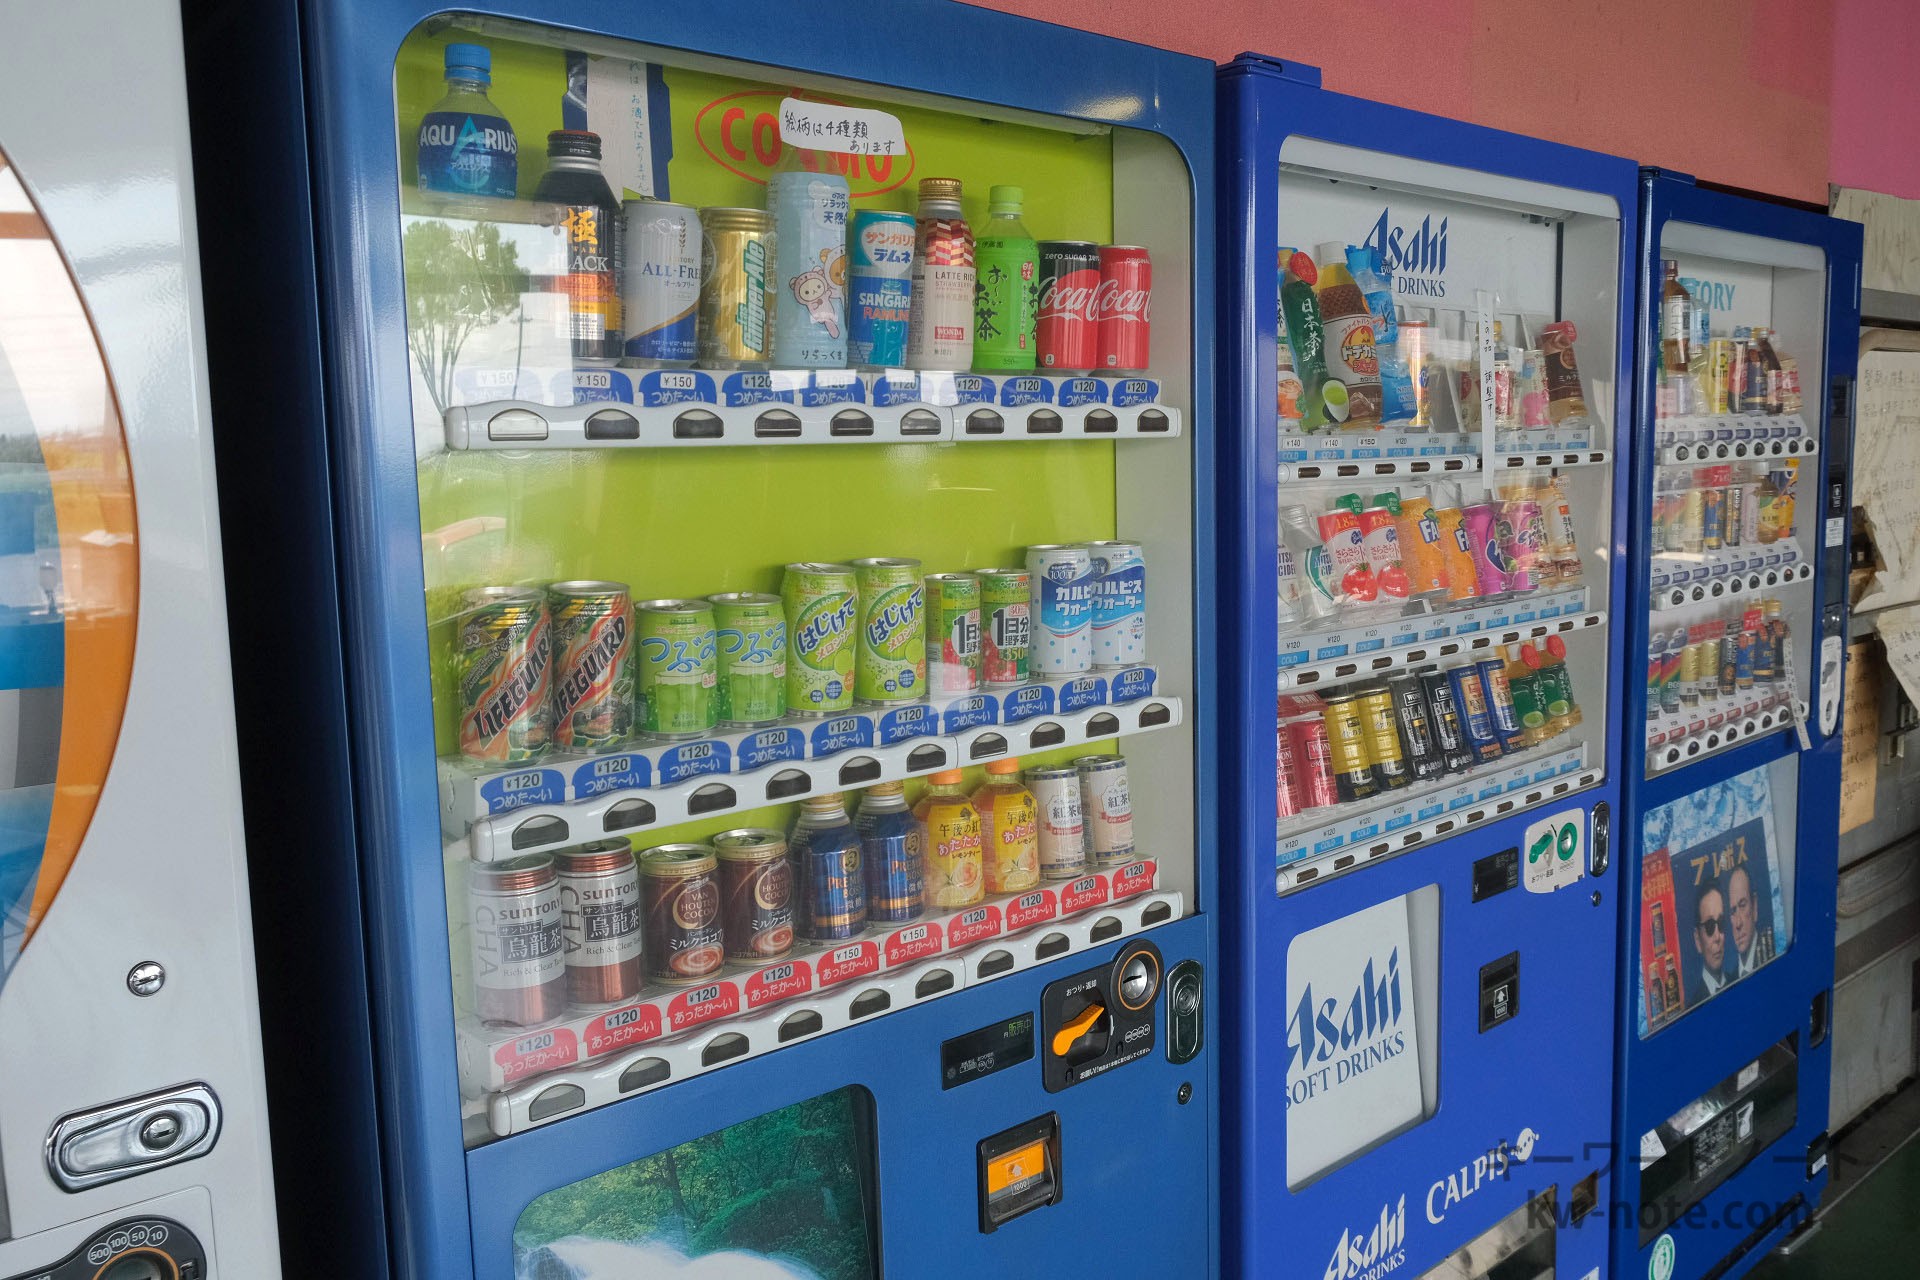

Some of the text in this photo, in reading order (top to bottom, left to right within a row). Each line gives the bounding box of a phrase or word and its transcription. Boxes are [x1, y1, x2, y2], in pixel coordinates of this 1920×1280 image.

[784, 109, 869, 139] 絵柄は4種類
[420, 115, 517, 158] AQUARIUS
[849, 139, 895, 155] あります
[560, 207, 599, 245] 極
[1362, 206, 1449, 276] Asahi
[873, 248, 911, 264] ラムネ
[935, 271, 961, 281] LATTE
[1398, 275, 1446, 299] DRINKS
[1301, 297, 1323, 356] 日本茶
[576, 374, 607, 387] ¥150
[664, 376, 692, 388] ¥150
[744, 374, 772, 388] ¥120
[958, 378, 980, 390] ¥120
[1017, 378, 1039, 391] ¥120
[1074, 381, 1094, 392] ¥120
[1127, 381, 1146, 393] ¥120
[1091, 579, 1142, 596] カルピス
[1091, 595, 1142, 611] ウォーター
[867, 585, 923, 646] はじけて
[796, 594, 855, 655] はじけて
[1281, 655, 1298, 666] COLD
[1320, 649, 1336, 658] COLD
[1125, 670, 1144, 683] ¥120
[1073, 679, 1094, 692] ¥120
[1019, 688, 1040, 701] ¥120
[899, 708, 922, 721] ¥120
[830, 719, 855, 733] ¥120
[759, 731, 785, 746] ¥120
[681, 744, 709, 759] ¥120
[597, 758, 628, 773] ¥120
[506, 773, 540, 789] ¥120
[939, 818, 981, 838] 午後の紅
[1356, 828, 1371, 838] COLD
[1319, 839, 1336, 849] COLD
[1282, 851, 1299, 861] COLD
[1125, 865, 1144, 877] ¥120
[1075, 879, 1095, 891] ¥120
[691, 891, 709, 901] VAN
[1020, 893, 1041, 907] ¥120
[584, 903, 622, 914] サントリー
[590, 908, 639, 939] 烏龍茶
[962, 910, 986, 924] ¥120
[500, 923, 542, 935] サントリー
[902, 928, 925, 942] ¥150
[507, 929, 562, 960] 烏龍茶
[585, 945, 606, 955] Rich
[837, 947, 860, 961] ¥150
[502, 966, 524, 978] Rich
[764, 965, 792, 982] ¥120
[688, 987, 718, 1003] ¥120
[1066, 980, 1097, 997] おつり・返却
[1287, 945, 1402, 1074] Asahi
[606, 1009, 639, 1027] ¥120
[1008, 1017, 1032, 1038] 販売中
[518, 1034, 552, 1053] ¥120
[1287, 1030, 1406, 1111] SOFT DRINKS
[1426, 1141, 1510, 1225] CALPIS
[1323, 1193, 1406, 1280] Asahi
[89, 1229, 163, 1262] 500 100 50 10
